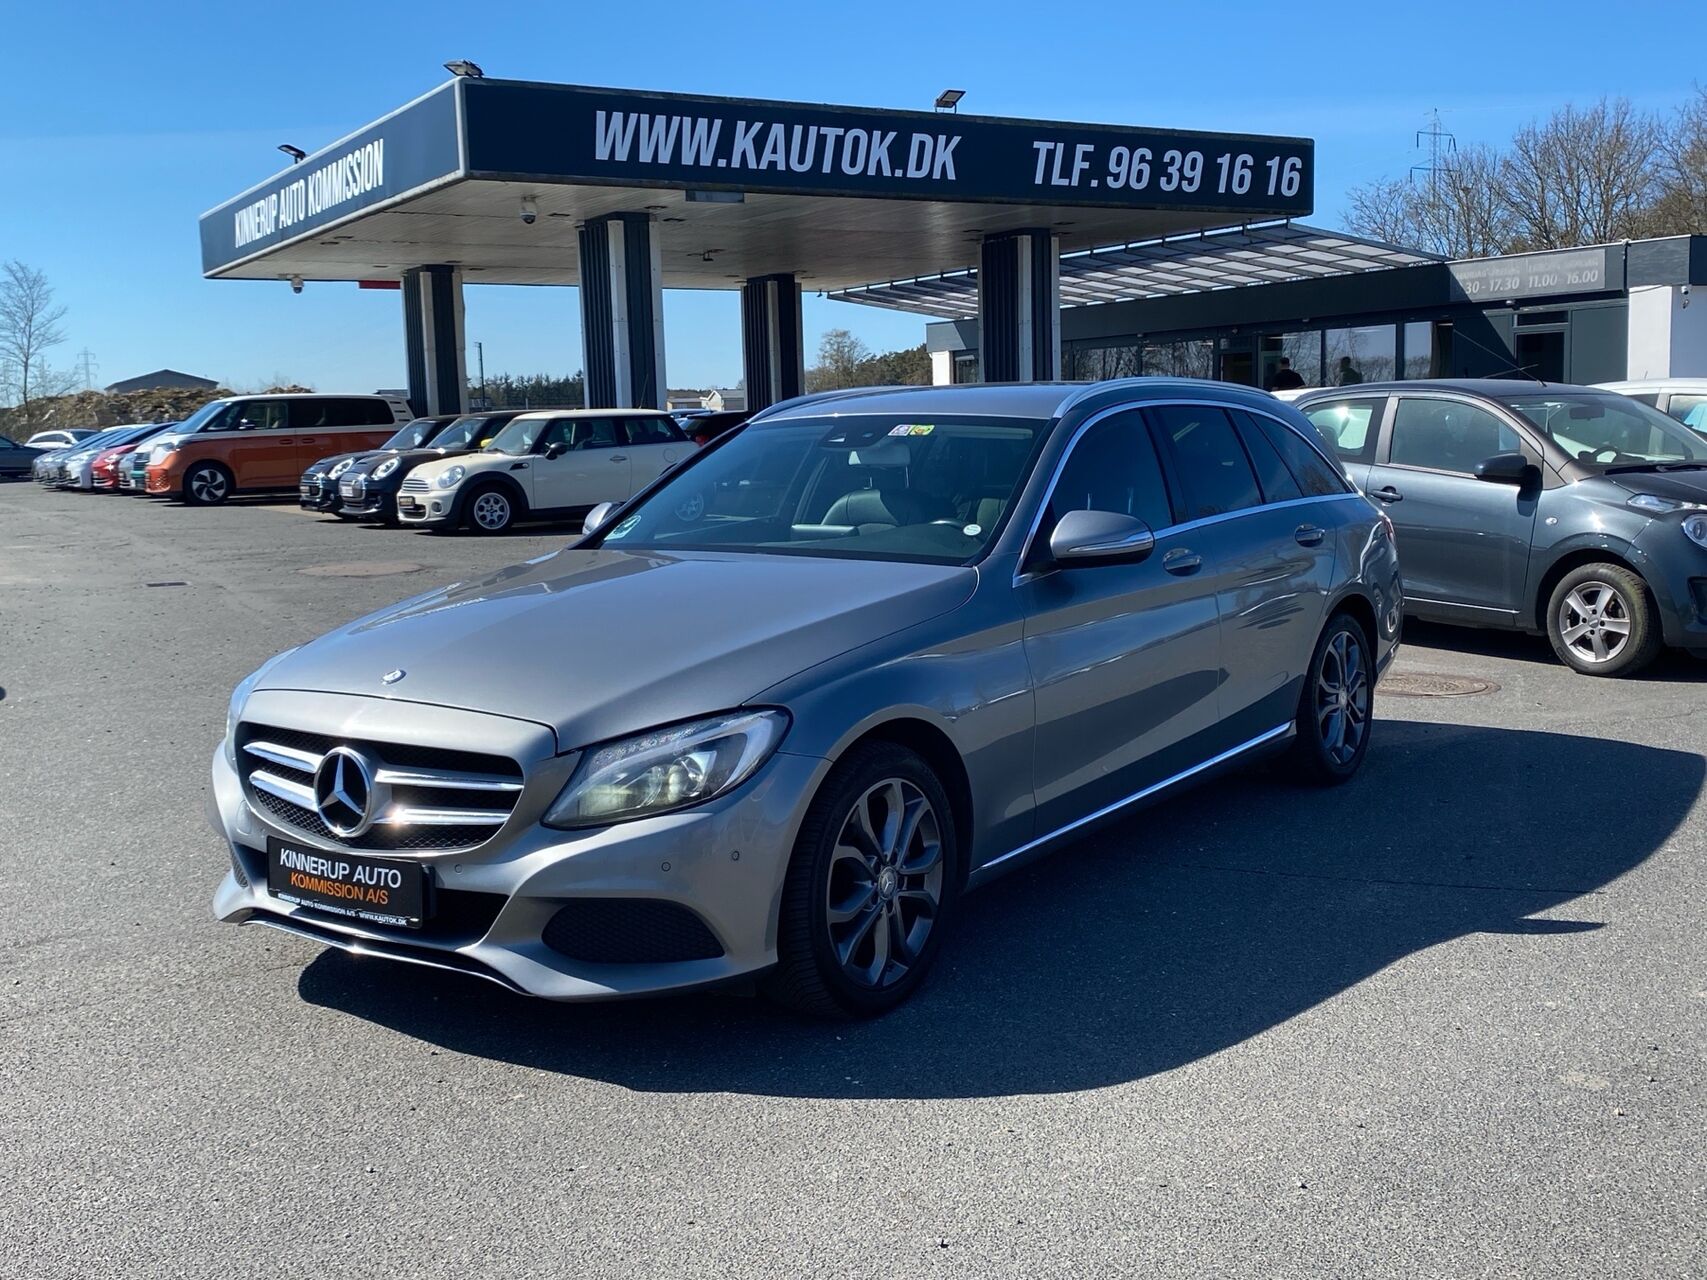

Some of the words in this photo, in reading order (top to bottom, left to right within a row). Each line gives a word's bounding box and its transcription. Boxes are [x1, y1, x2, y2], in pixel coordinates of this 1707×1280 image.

[594, 110, 962, 181] WWW.KAUTOK.DK
[1033, 141, 1098, 188] TLF.
[1107, 145, 1151, 191] 96
[1160, 149, 1203, 193] 39
[1217, 152, 1254, 195] 16
[1265, 155, 1303, 198] 16
[235, 193, 277, 248] KINNERUP
[279, 178, 305, 230] AUTO
[308, 138, 384, 217] KOMMISSION
[280, 848, 350, 880] KINNERUP
[353, 865, 401, 889] AUTO
[290, 872, 364, 901] KOMMISSION
[367, 888, 389, 905] A/S
